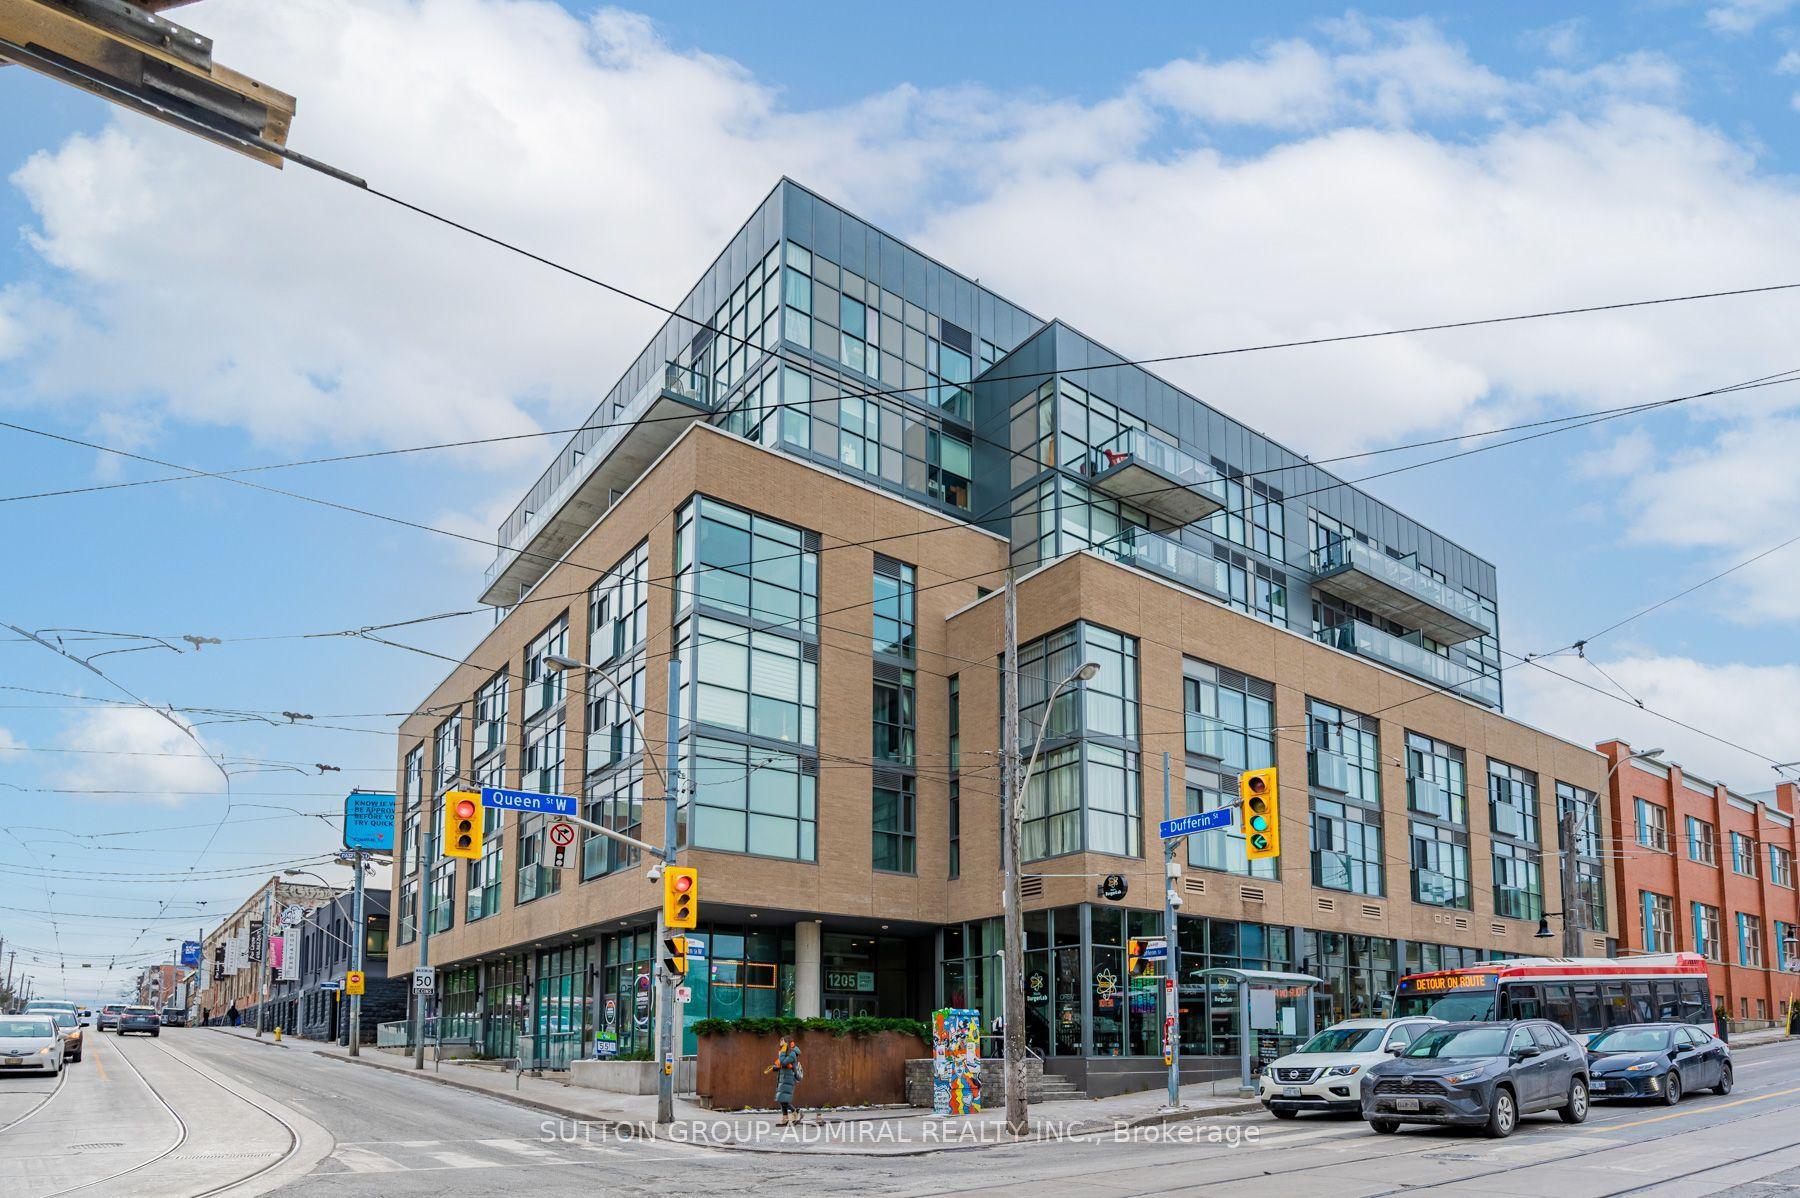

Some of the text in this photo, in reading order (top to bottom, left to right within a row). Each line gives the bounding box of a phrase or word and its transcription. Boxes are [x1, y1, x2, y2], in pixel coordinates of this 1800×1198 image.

[493, 792, 567, 811] Queen St W
[1170, 815, 1211, 833] Dufferin
[416, 976, 432, 987] 50
[828, 973, 856, 987] 1205
[1416, 975, 1486, 990] DETOUR ON ROUTE
